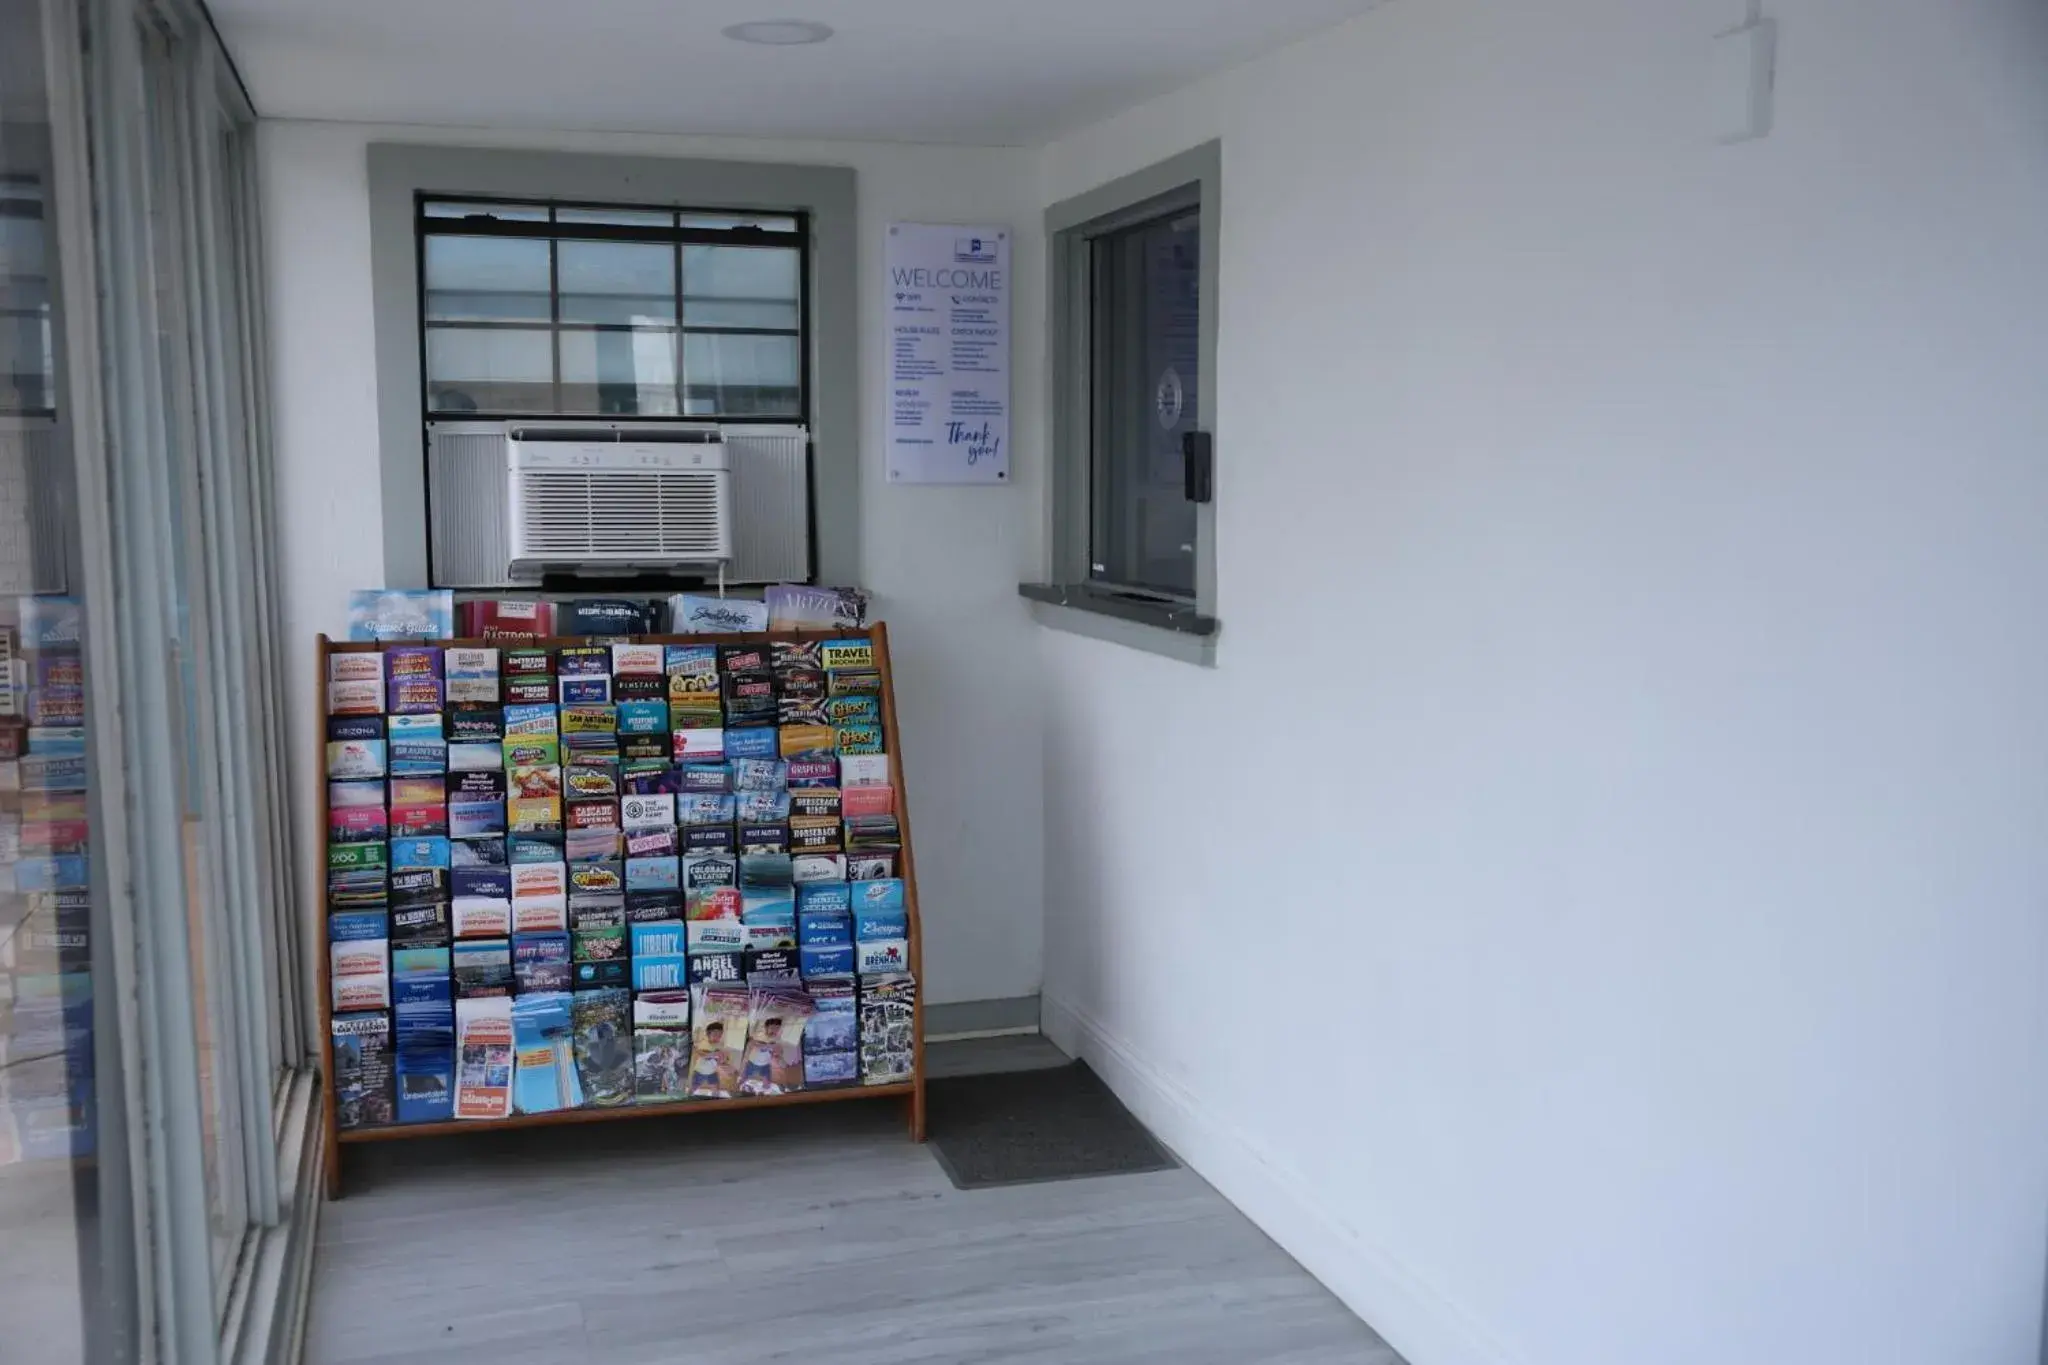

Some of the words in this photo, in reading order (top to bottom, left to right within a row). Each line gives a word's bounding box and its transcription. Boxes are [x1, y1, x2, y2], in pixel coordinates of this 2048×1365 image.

[893, 267, 1002, 290] WELCOME
[944, 422, 990, 444] Thank
[365, 620, 403, 632] Travel
[407, 623, 438, 636] Guide
[828, 650, 870, 658] TRAVEL
[792, 764, 831, 774] GRAPEVINE
[576, 806, 612, 816] CASCADE
[794, 828, 836, 838] HORSEBACK
[690, 866, 732, 874] COLORADO
[693, 956, 733, 972] ANGEL
[865, 955, 902, 966] BRENHAM
[711, 968, 738, 980] FIRE
